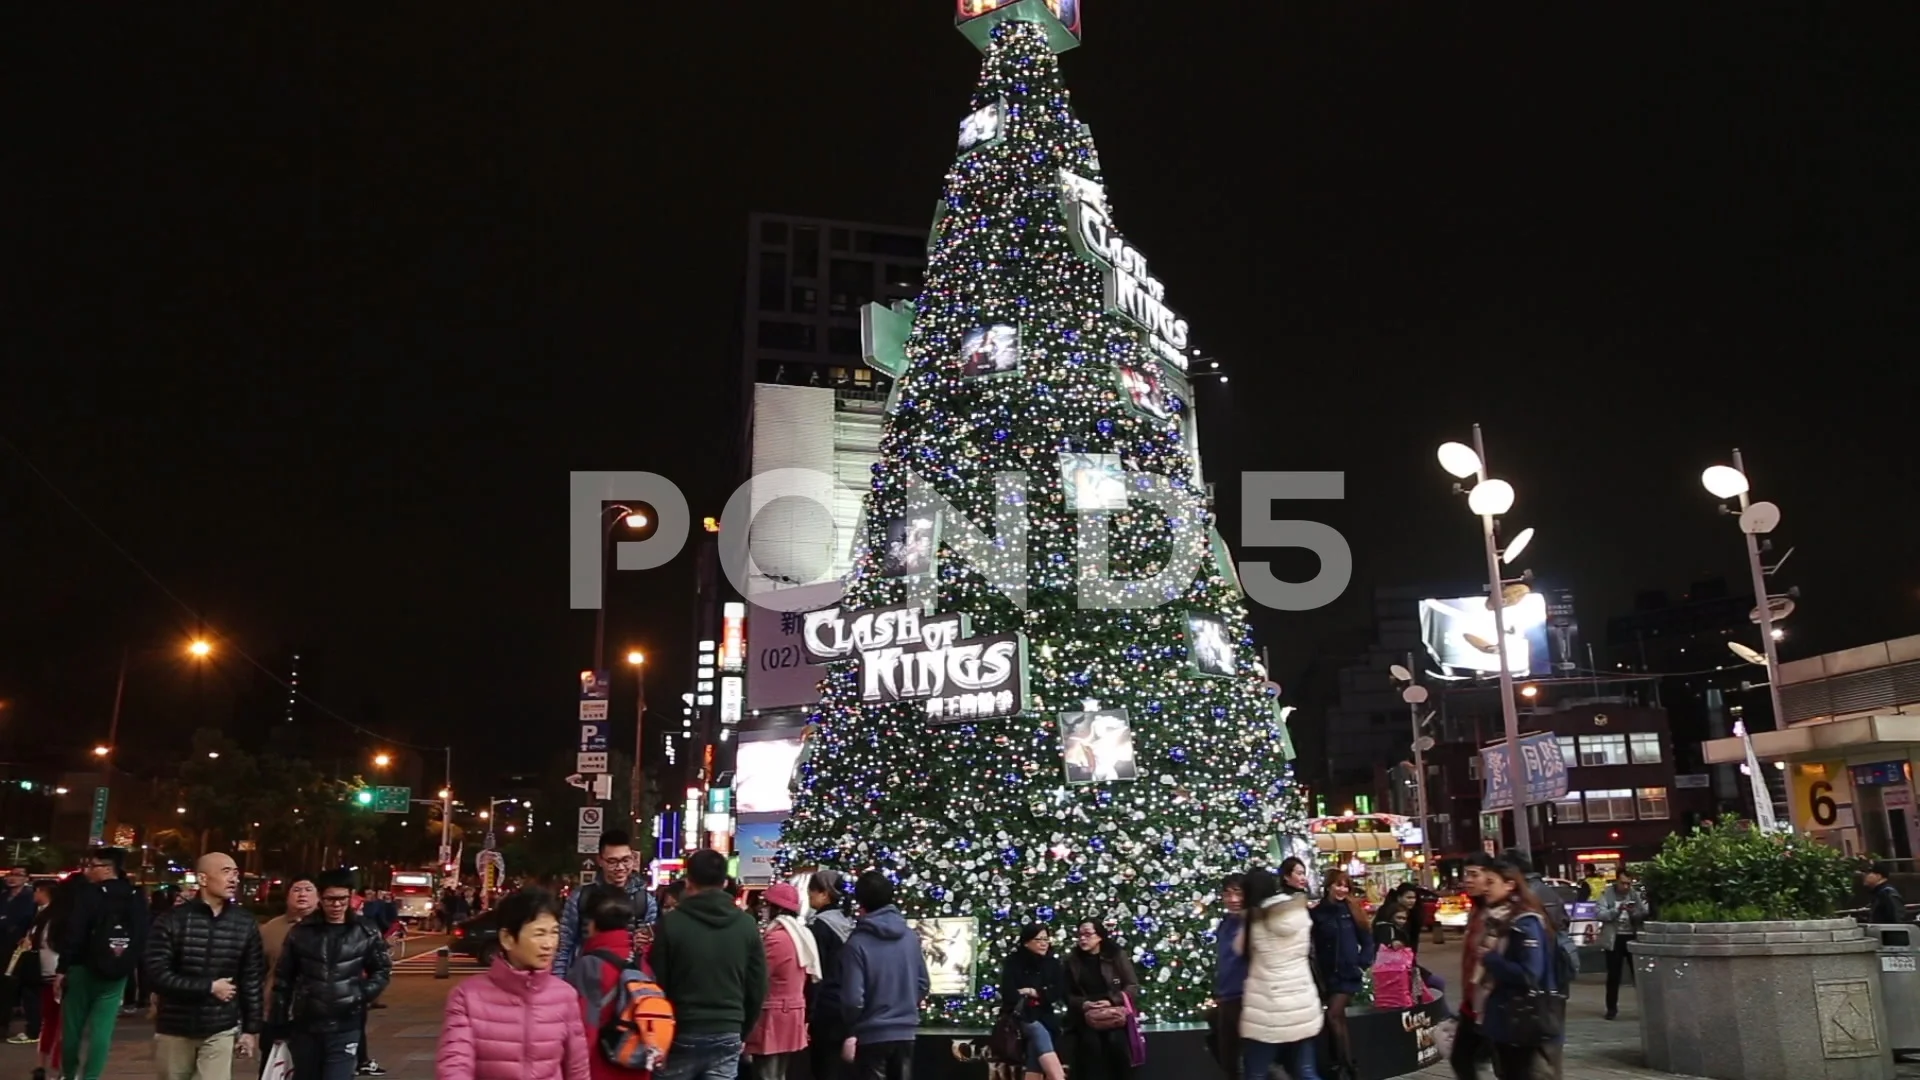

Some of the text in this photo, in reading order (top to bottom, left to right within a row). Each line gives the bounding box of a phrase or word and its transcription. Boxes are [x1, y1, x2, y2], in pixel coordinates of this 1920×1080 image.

[1081, 203, 1164, 301] CLASH OF
[1117, 267, 1189, 349] KINGS
[803, 607, 958, 657] CLASH OF
[761, 644, 800, 681] (02)
[862, 641, 1016, 700] KINGS
[582, 725, 598, 743] P
[1809, 781, 1837, 826] 6
